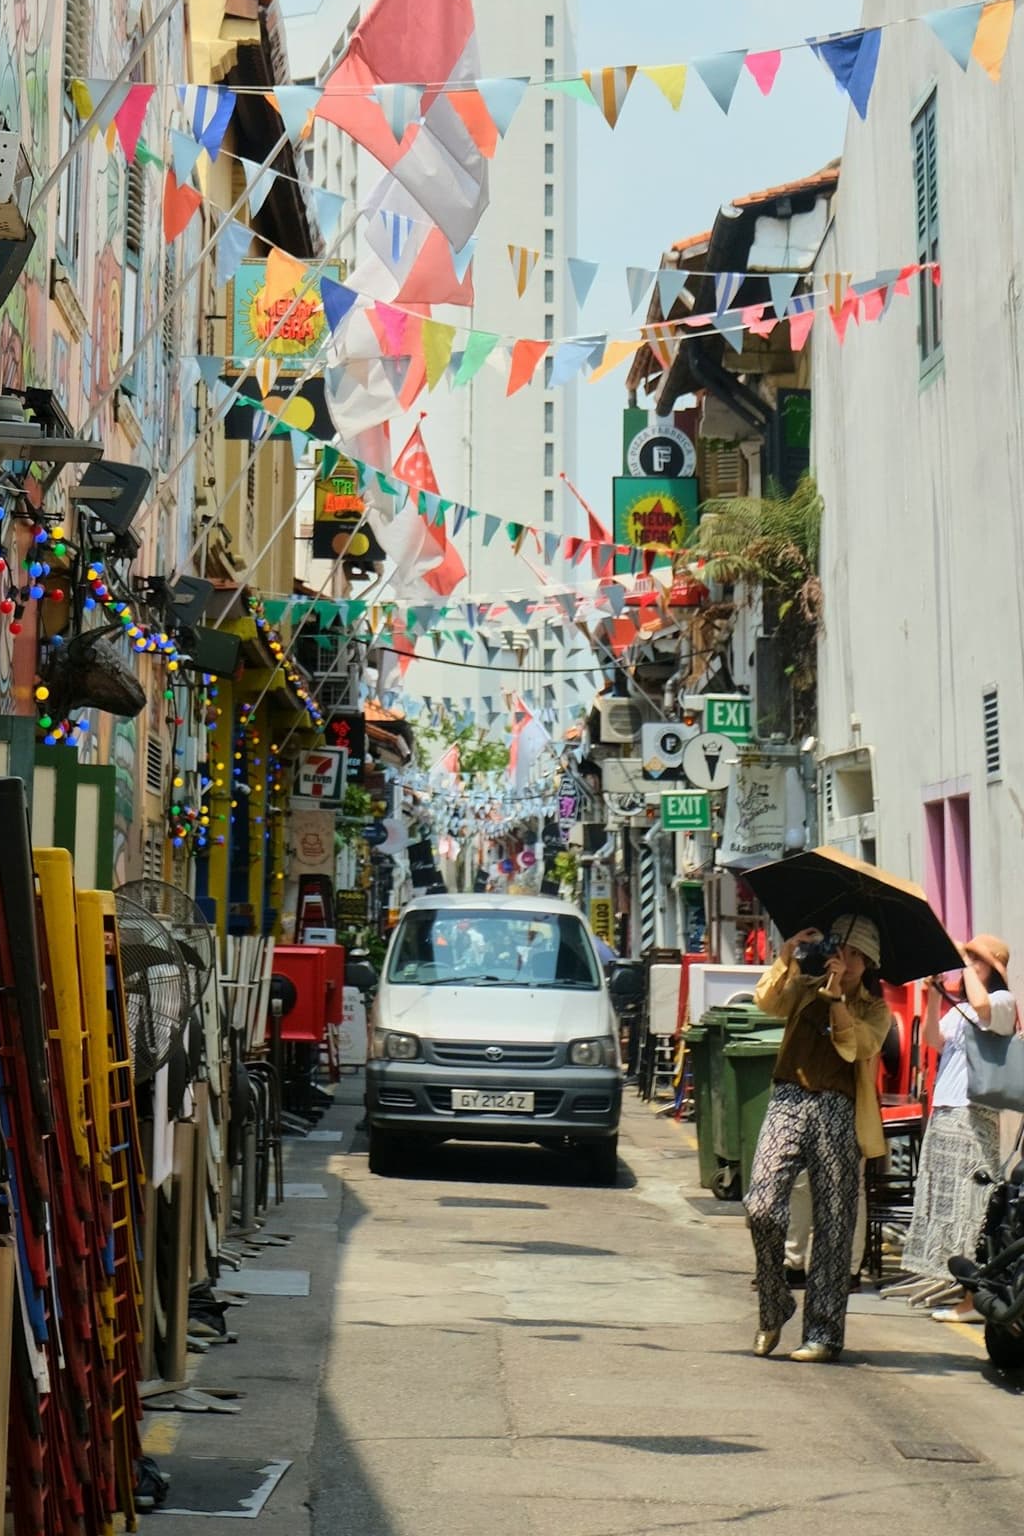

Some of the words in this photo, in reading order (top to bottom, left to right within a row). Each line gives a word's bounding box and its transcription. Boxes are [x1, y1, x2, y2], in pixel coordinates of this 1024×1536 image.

[653, 446, 671, 472] F
[632, 511, 682, 526] PIEDRA
[303, 774, 333, 784] ELEVEN
[667, 796, 703, 816] EXIT
